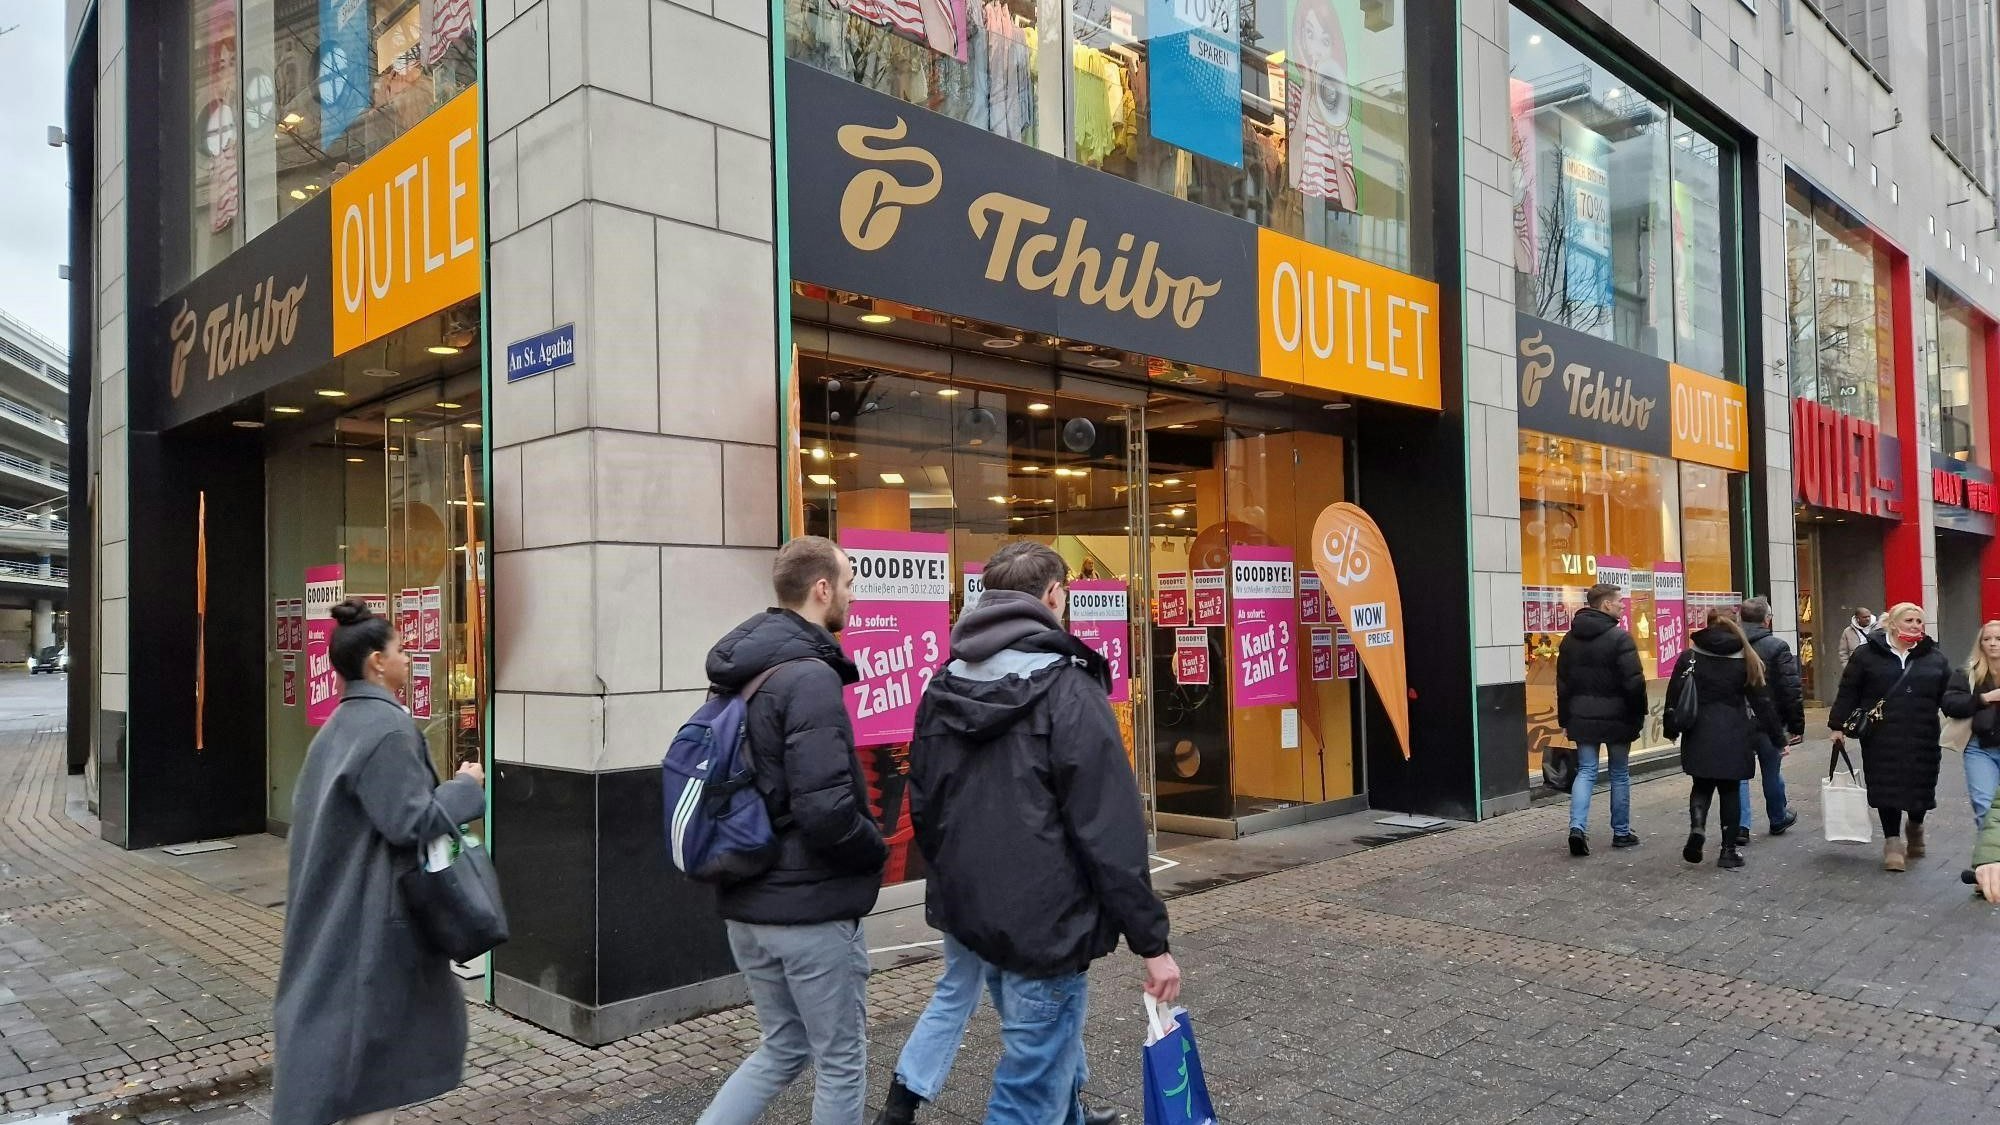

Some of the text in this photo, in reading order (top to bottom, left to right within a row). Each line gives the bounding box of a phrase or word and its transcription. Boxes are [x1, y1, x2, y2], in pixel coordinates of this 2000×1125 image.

[1198, 41, 1229, 66] SPAREN
[342, 127, 476, 313] OUTLE
[1580, 192, 1606, 223] 70%
[968, 192, 1222, 329] Tchibo
[203, 272, 308, 381] Tchibo
[1272, 261, 1429, 380] OUTLET
[509, 336, 573, 372] An St. Agatha
[1562, 362, 1656, 431] Tchibo
[1675, 382, 1742, 452] OUTLET
[1323, 525, 1370, 586] %
[1235, 566, 1292, 582] GOODBYE!
[307, 586, 342, 603] GOODBYE!
[860, 583, 895, 596] schließen
[898, 586, 909, 594] am
[911, 584, 945, 595] 30.12.2023
[1073, 594, 1124, 607] GOODBYE!
[1199, 596, 1222, 609] Kauf 3
[1162, 597, 1185, 610] Kauf 3
[1163, 607, 1184, 619] Zahl 2
[1199, 606, 1221, 619] Zahl 2
[1238, 610, 1266, 619] Ab sofort:
[1355, 606, 1382, 627] WOW
[849, 615, 898, 627] Ab sofort:
[1659, 616, 1682, 643] Kauf 3
[1112, 638, 1121, 657] 3
[1241, 620, 1290, 660] Kauf 3
[1367, 631, 1391, 645] PREISE
[1660, 636, 1682, 664] Zahl 2
[853, 631, 939, 681] Kauf 3
[1182, 654, 1205, 667] Kauf 3
[1182, 664, 1204, 676] Zahl 2
[1242, 652, 1275, 687] Zahl
[310, 674, 330, 706] Zahl
[331, 671, 338, 696] 2
[853, 672, 912, 719] Zahl
